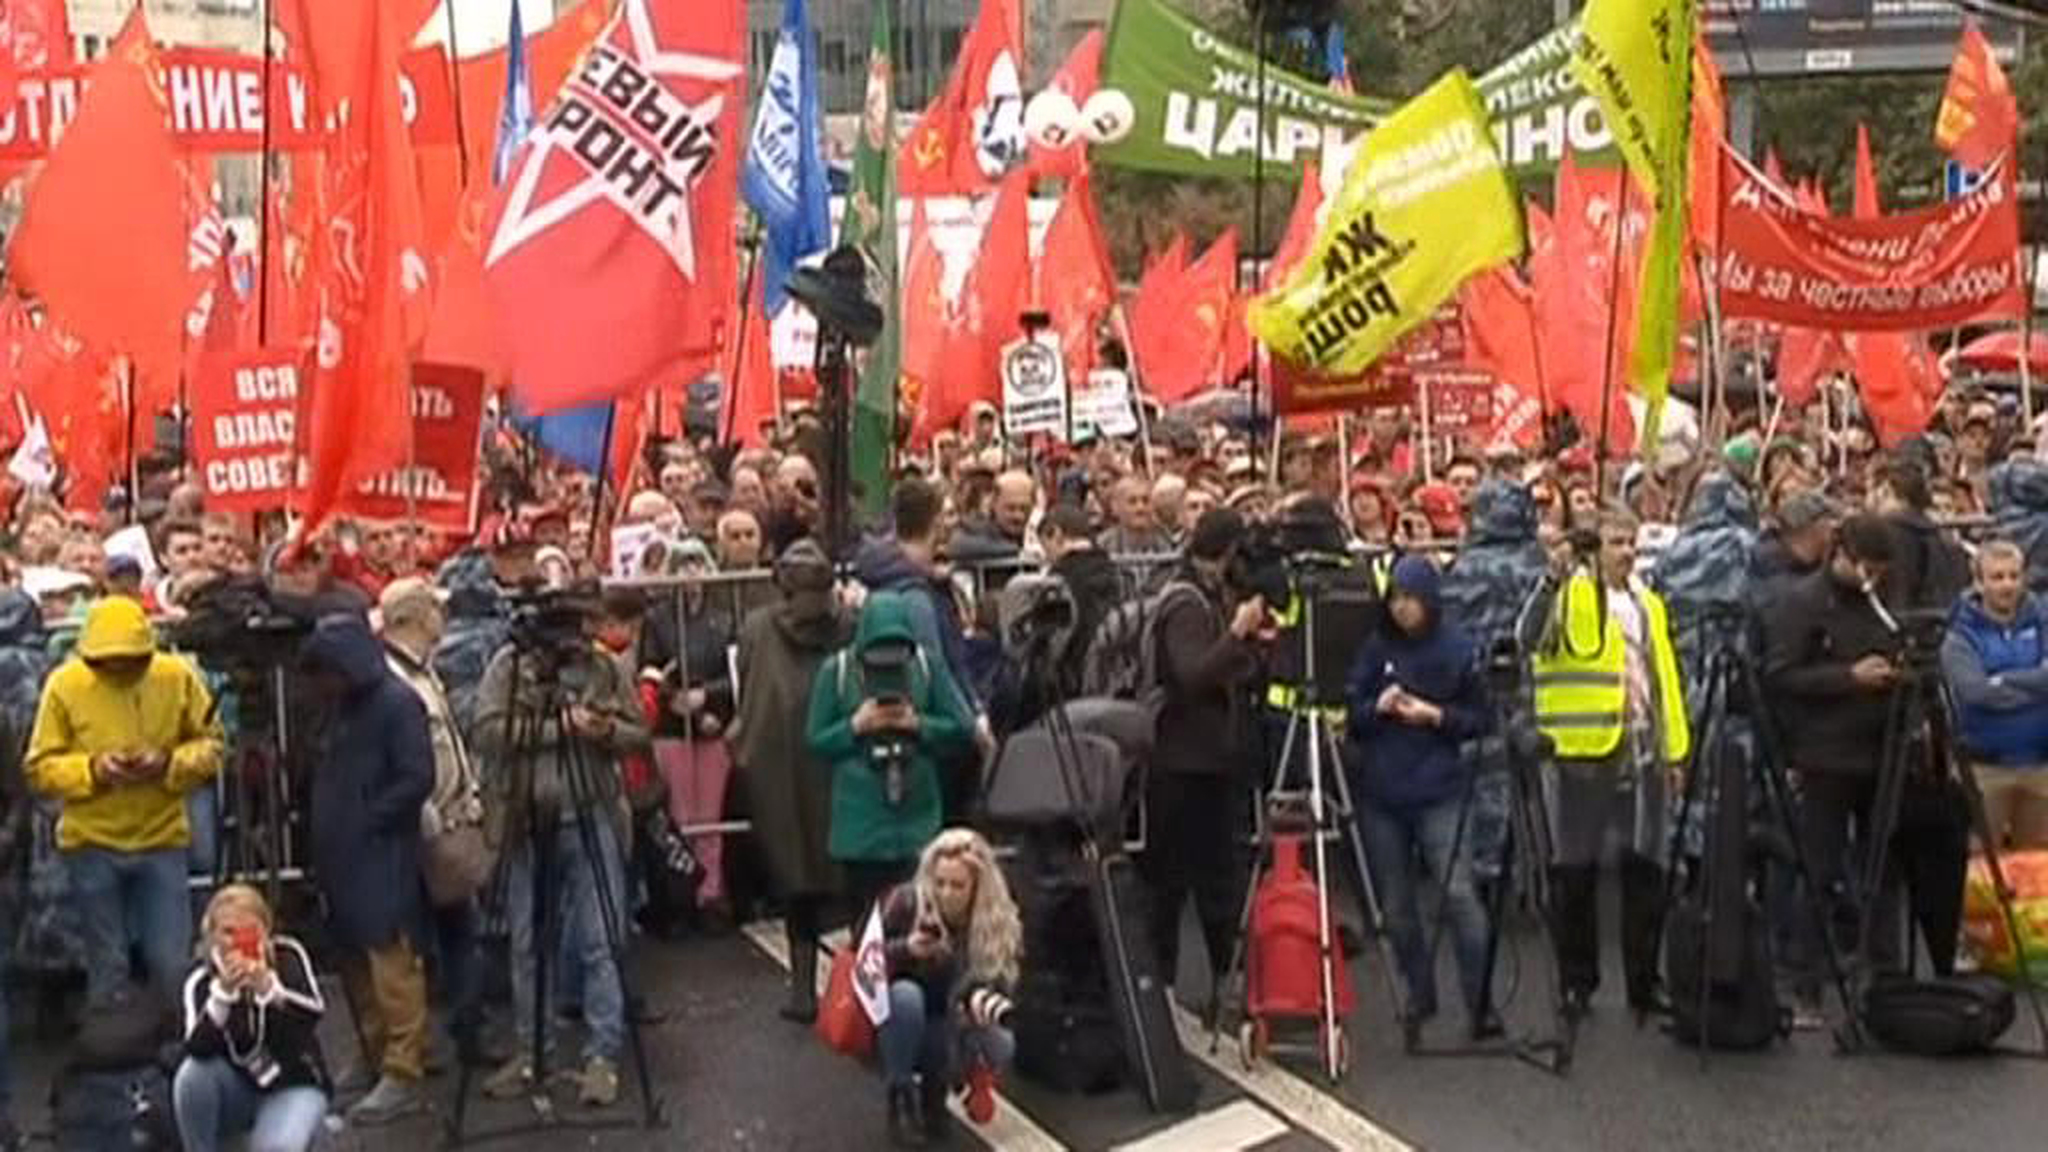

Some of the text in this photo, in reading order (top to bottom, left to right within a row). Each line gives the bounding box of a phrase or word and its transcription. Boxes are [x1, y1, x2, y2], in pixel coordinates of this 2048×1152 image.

[163, 65, 266, 131] НИЕ
[547, 97, 684, 216] РОНТ
[236, 364, 297, 401] ВСЯ
[214, 411, 295, 449] ВЛАС
